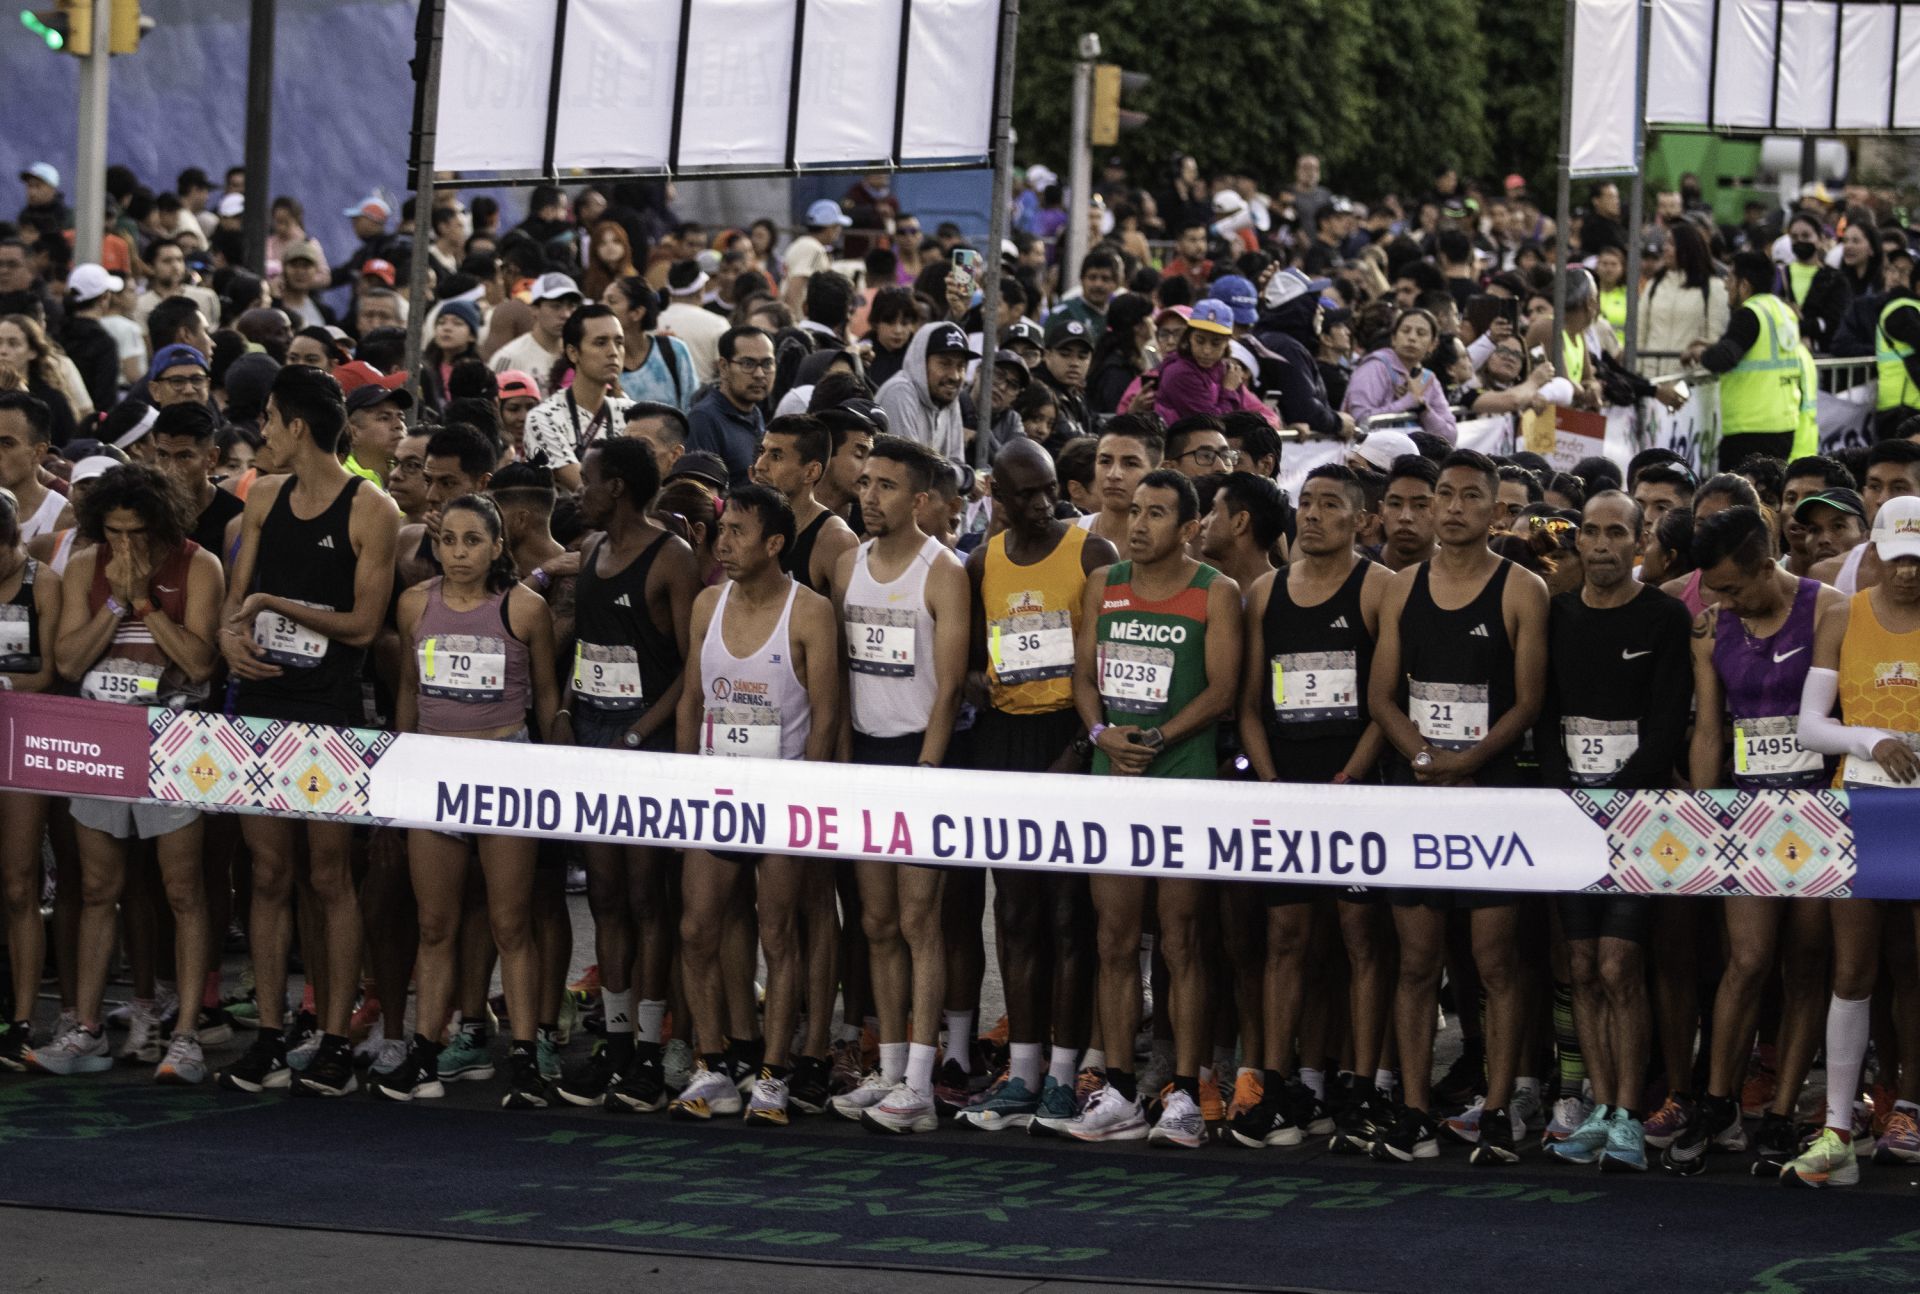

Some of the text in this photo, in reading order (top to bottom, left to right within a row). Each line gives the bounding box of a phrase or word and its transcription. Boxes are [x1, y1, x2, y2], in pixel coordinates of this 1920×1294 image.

[275, 617, 298, 634] 33
[1110, 619, 1186, 643] MÉXICO
[866, 627, 884, 644] 20
[1018, 634, 1040, 651] 36
[449, 655, 471, 671] 70
[593, 664, 604, 679] 9
[1105, 662, 1157, 683] 10238
[1305, 673, 1316, 689] 3
[99, 675, 138, 693] 1356
[732, 692, 764, 706] ARENAS
[1430, 704, 1453, 721] 21
[727, 727, 749, 743] 45
[25, 735, 101, 757] INSTITUTO
[1582, 738, 1604, 755] 25
[24, 754, 125, 779] DEL DEPORTE
[436, 781, 561, 831] MEDIO
[787, 804, 839, 851] DE
[861, 809, 914, 856] LA
[932, 813, 1108, 865] CIUDAD
[1130, 823, 1184, 868] DE
[1413, 832, 1535, 871] BBVA
[703, 1142, 1057, 1175] MEDIO
